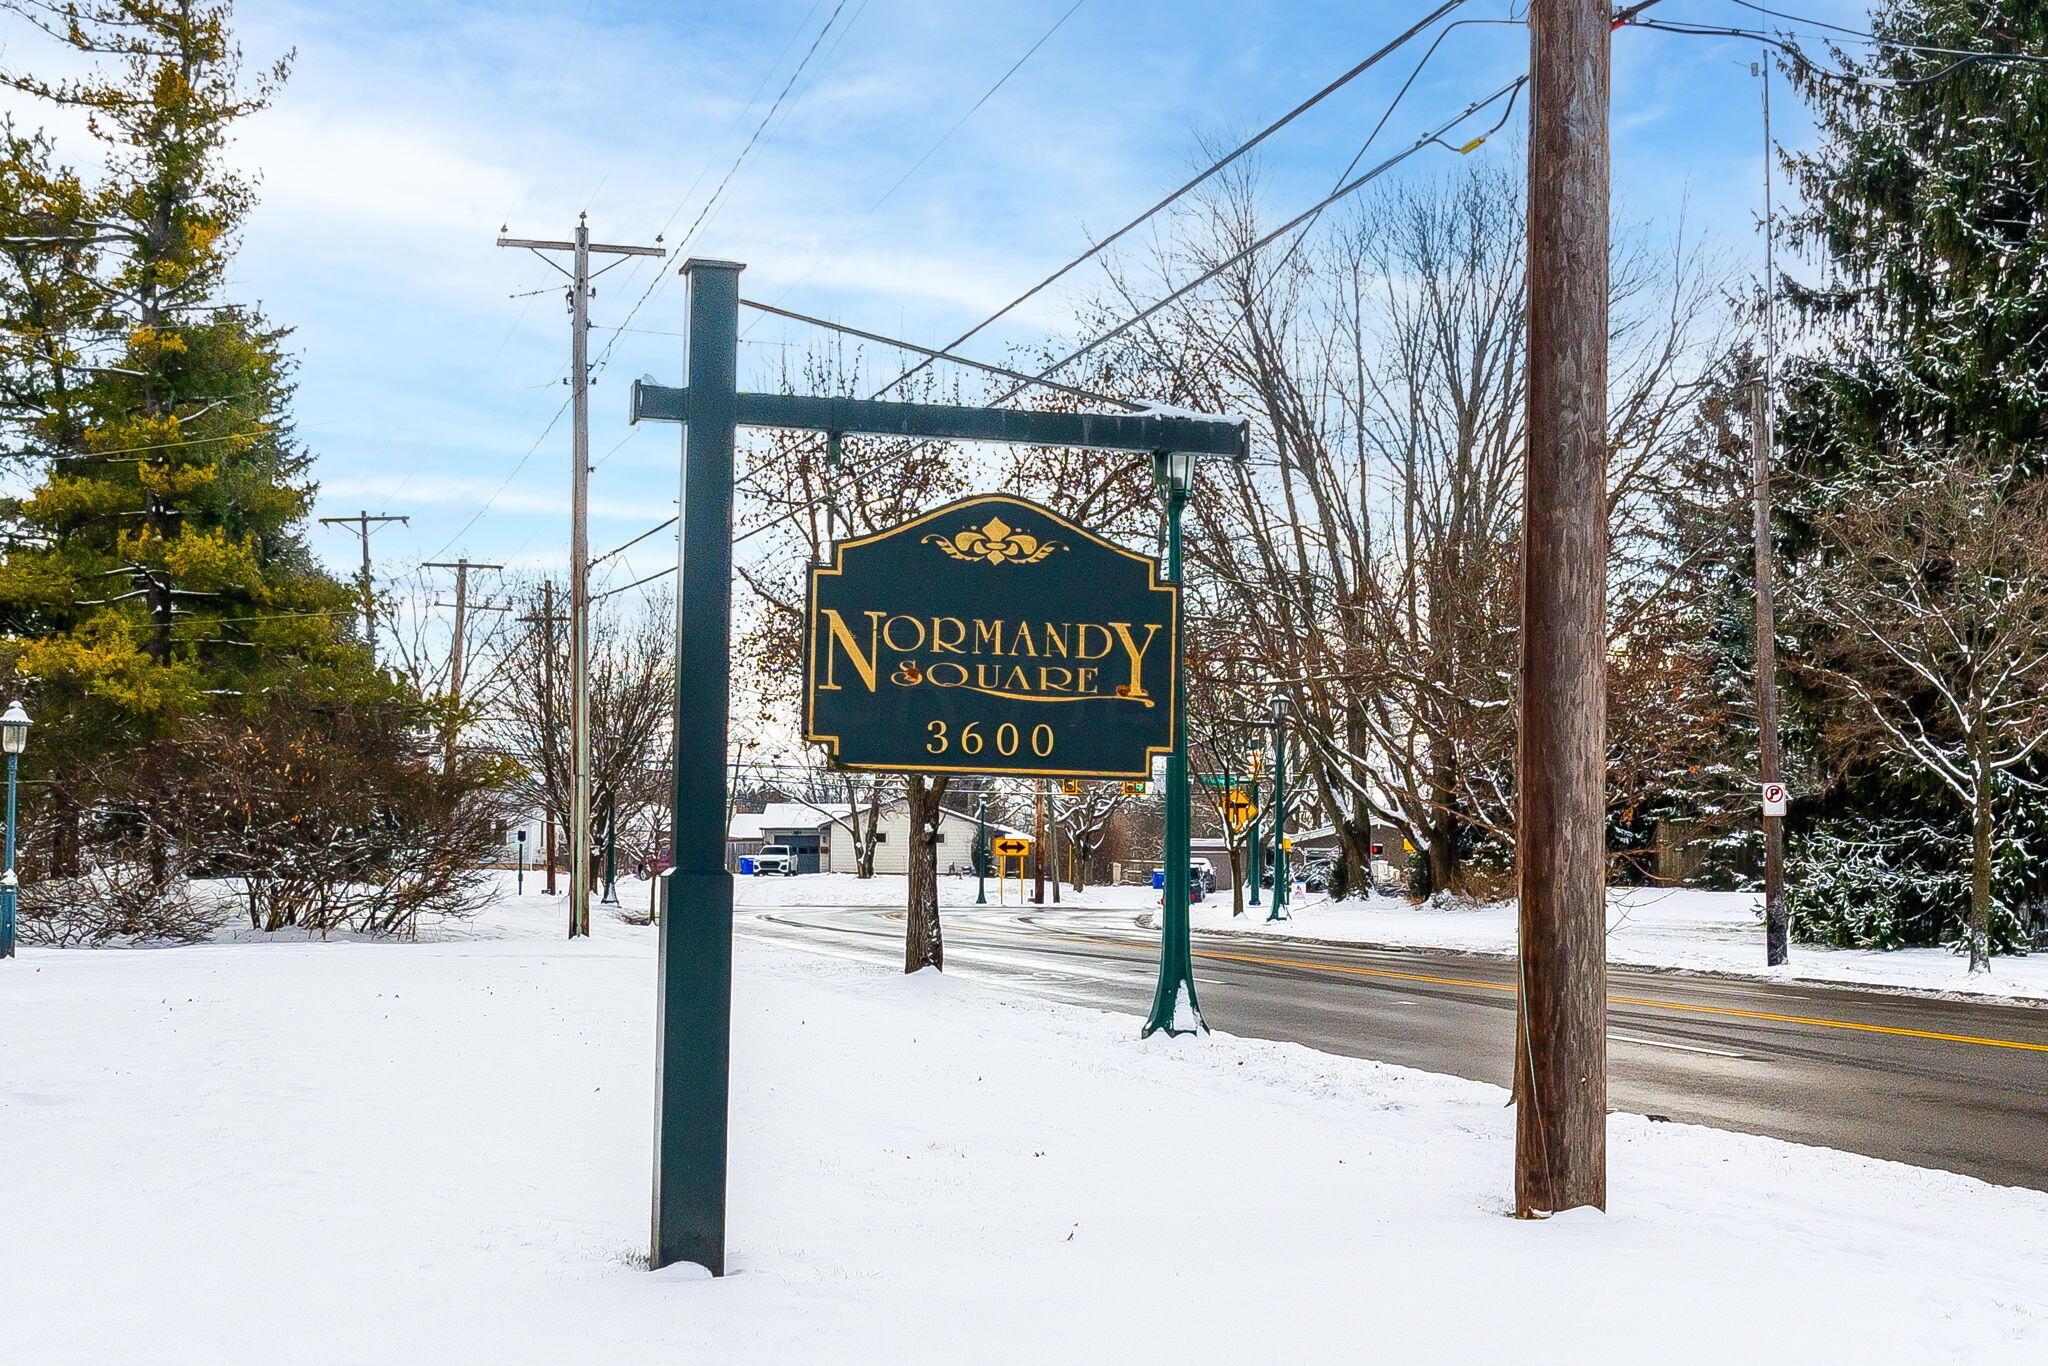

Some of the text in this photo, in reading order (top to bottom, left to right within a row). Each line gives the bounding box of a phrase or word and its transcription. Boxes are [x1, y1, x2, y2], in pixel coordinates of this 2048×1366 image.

[818, 608, 1163, 697] NORMANDY
[890, 659, 1099, 702] SQUARE
[926, 720, 1054, 757] 3600
